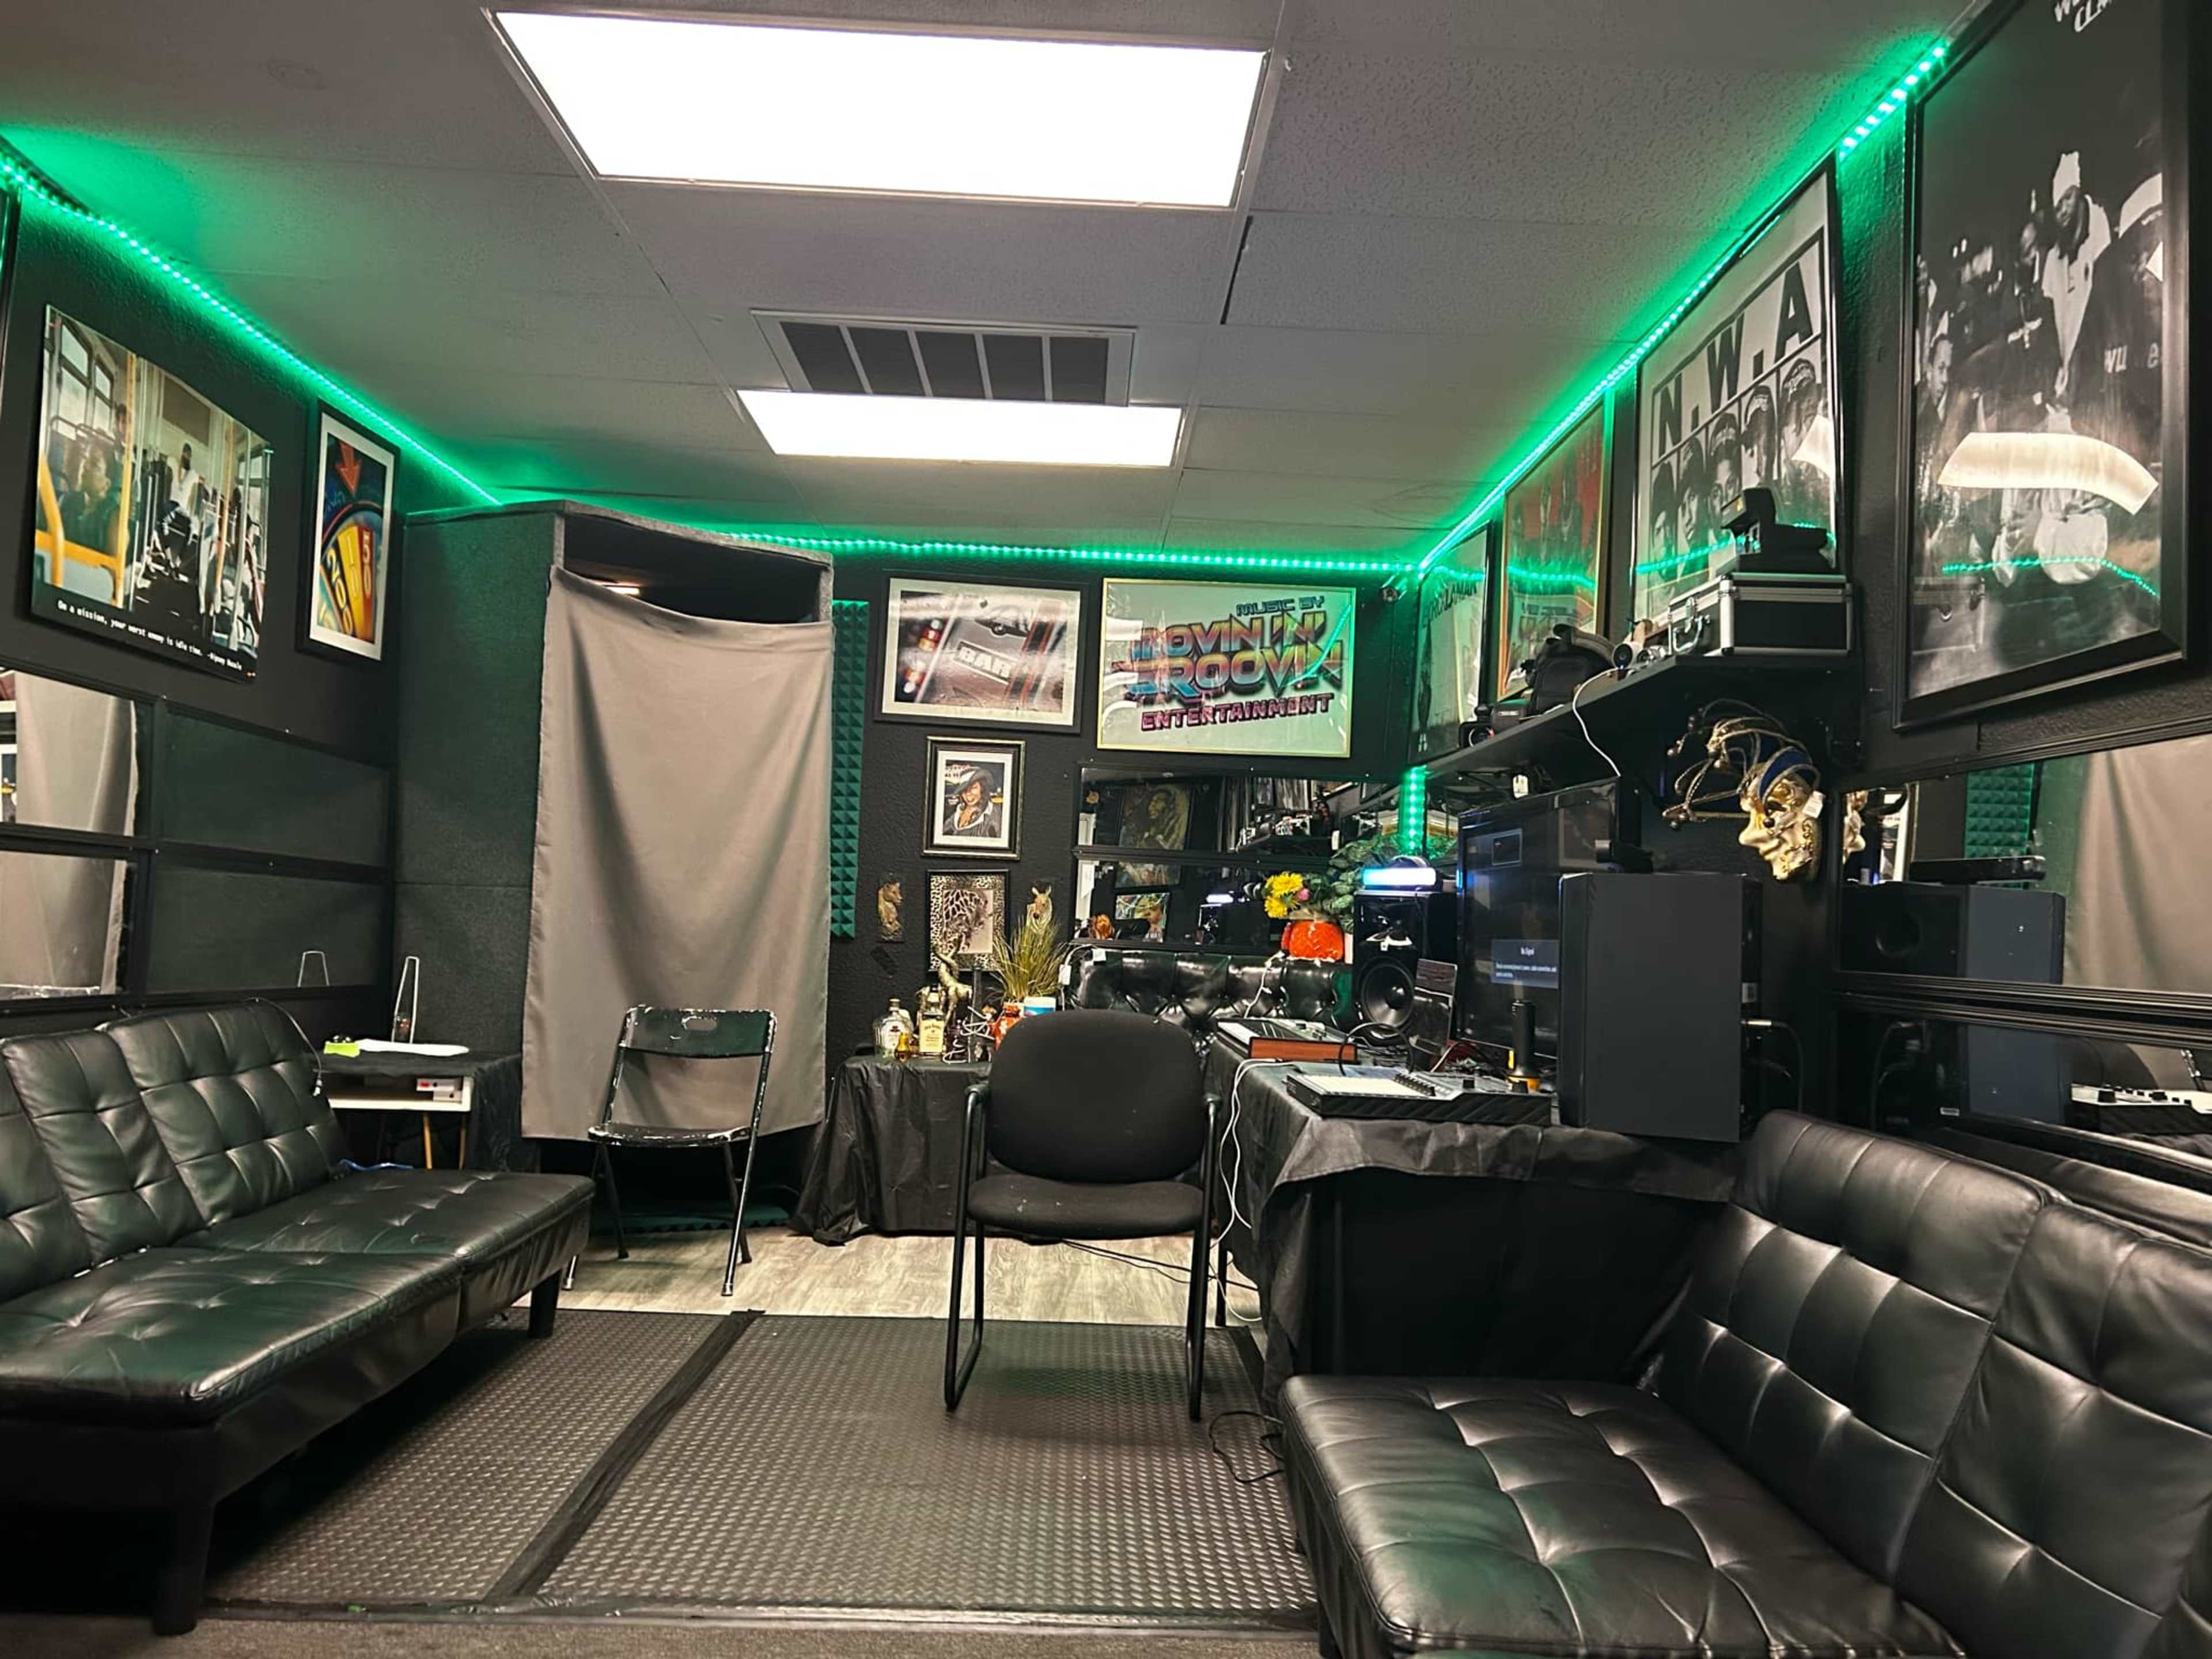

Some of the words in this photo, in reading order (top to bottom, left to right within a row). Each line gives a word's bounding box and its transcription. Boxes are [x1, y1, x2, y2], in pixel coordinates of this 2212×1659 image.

[327, 547, 353, 635] 200
[1236, 598, 1296, 616] MUSIC
[1298, 596, 1325, 610] BY
[958, 646, 1012, 679] BAR
[1141, 693, 1334, 732] ENTERTAINMENT
